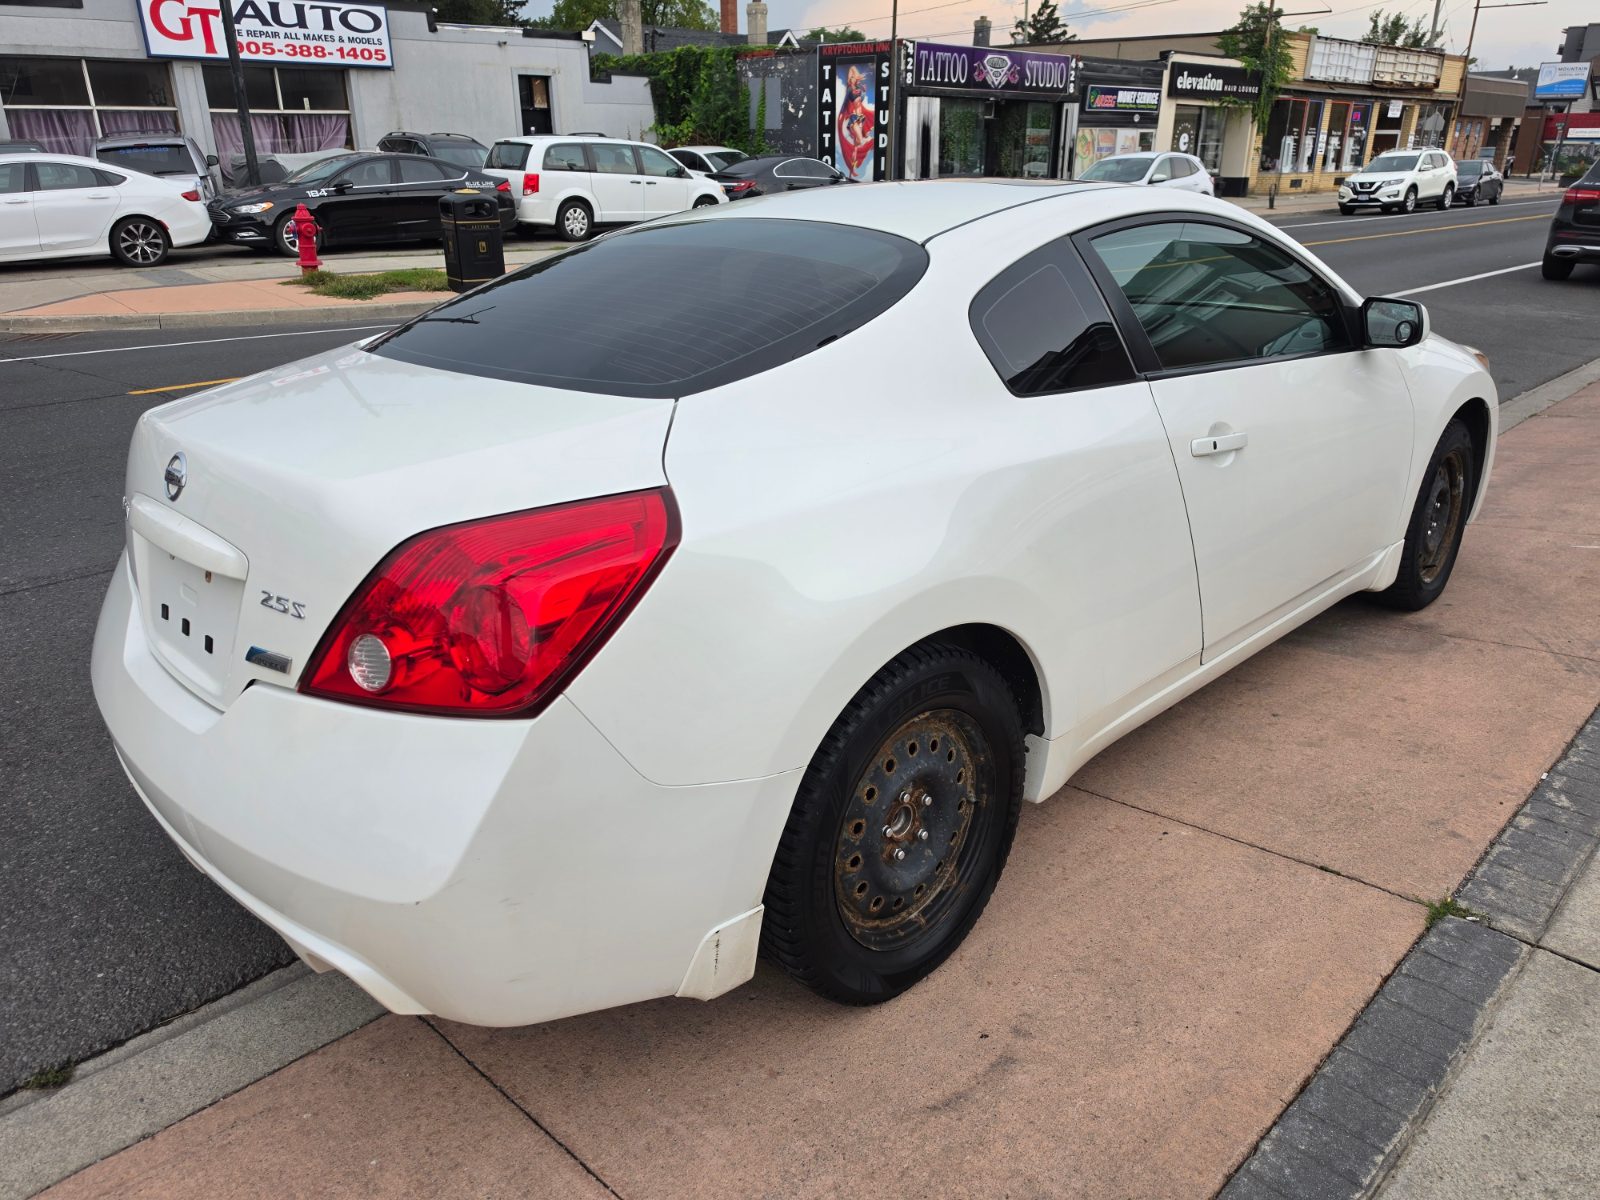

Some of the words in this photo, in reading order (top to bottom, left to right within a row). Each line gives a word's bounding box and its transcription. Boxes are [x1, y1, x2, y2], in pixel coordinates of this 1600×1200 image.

[149, 0, 221, 54] GT
[232, 0, 383, 34] AUTO
[235, 29, 244, 37] E
[246, 29, 281, 40] REPAIR
[283, 31, 301, 41] ALL
[303, 33, 336, 43] MAKES
[338, 35, 346, 43] &
[347, 36, 383, 46] MODELS
[236, 40, 387, 62] 905-388-1405
[822, 44, 874, 56] KRYPTONIAN
[906, 42, 915, 84] 428
[919, 50, 968, 84] TATTOO
[1024, 59, 1067, 89] STUDIO
[1068, 58, 1077, 94] 428
[1176, 70, 1224, 92] elevation
[1223, 84, 1238, 92] HAIR
[1238, 85, 1259, 94] LOUNGE
[305, 188, 328, 198] 184
